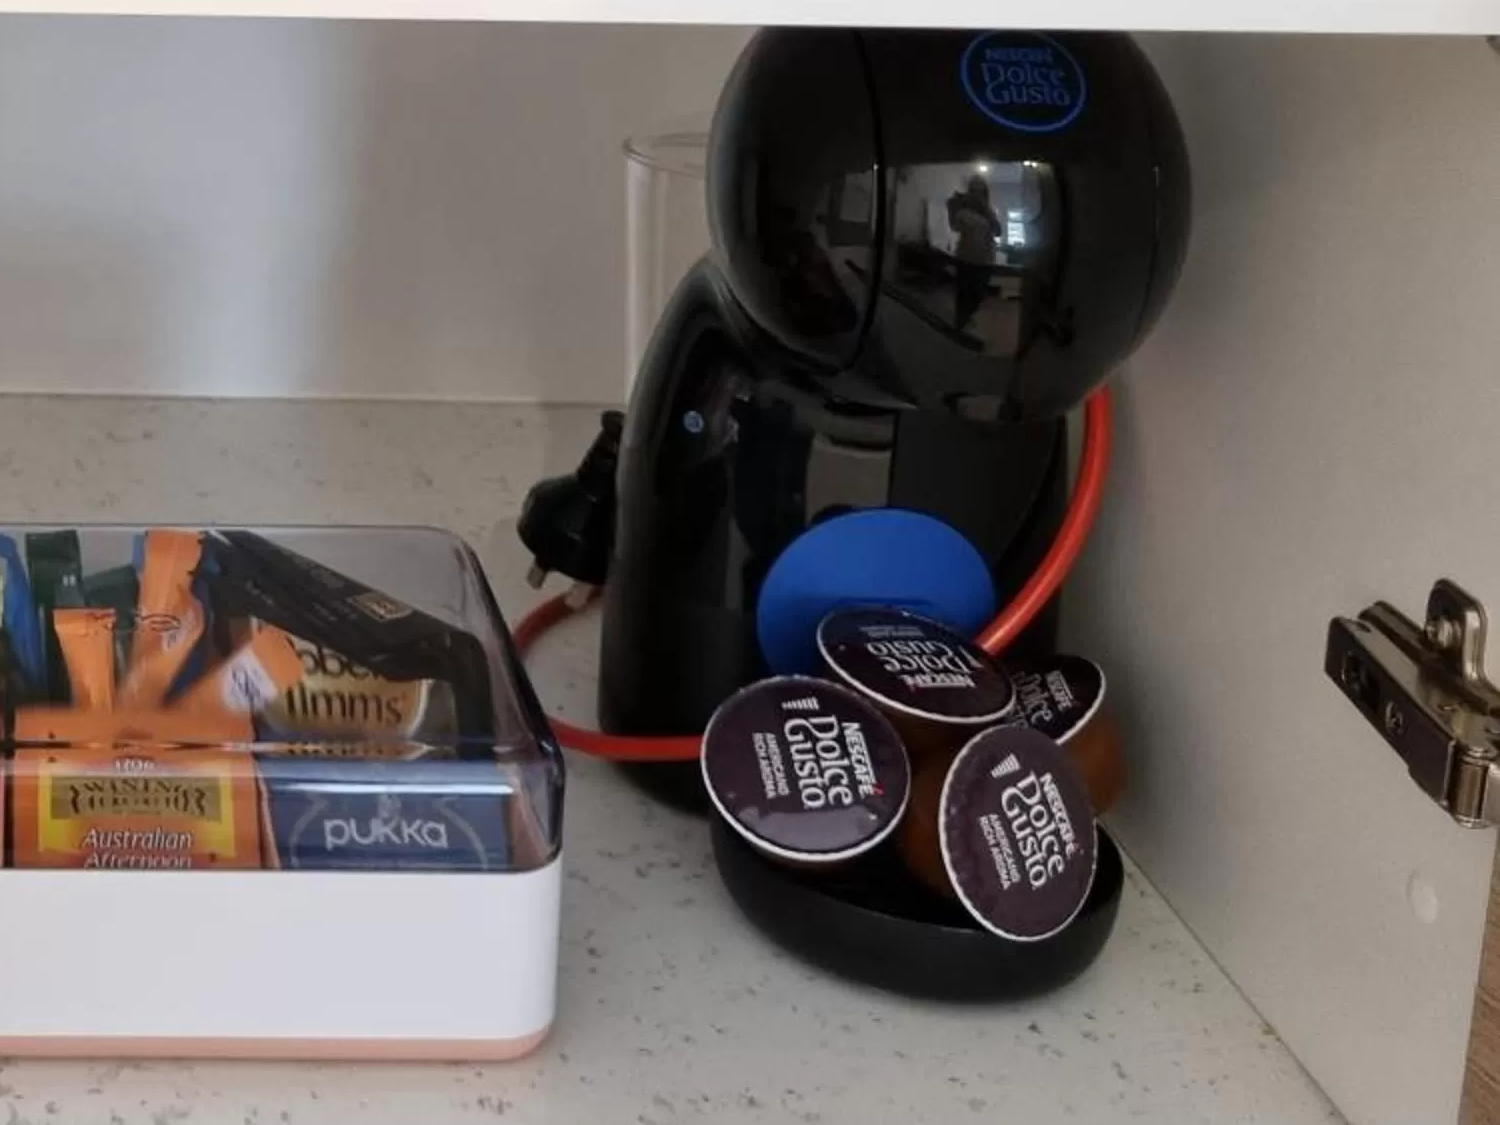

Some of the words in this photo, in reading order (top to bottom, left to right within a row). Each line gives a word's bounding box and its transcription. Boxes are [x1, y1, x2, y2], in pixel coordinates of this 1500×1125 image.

[980, 62, 1068, 86] Dolce
[985, 79, 1072, 106] Gusto
[783, 717, 827, 810] Gusto
[808, 714, 854, 807] Dolce
[82, 826, 193, 851] Australian
[1000, 784, 1050, 890] Gusto
[1016, 773, 1066, 878] Dolce
